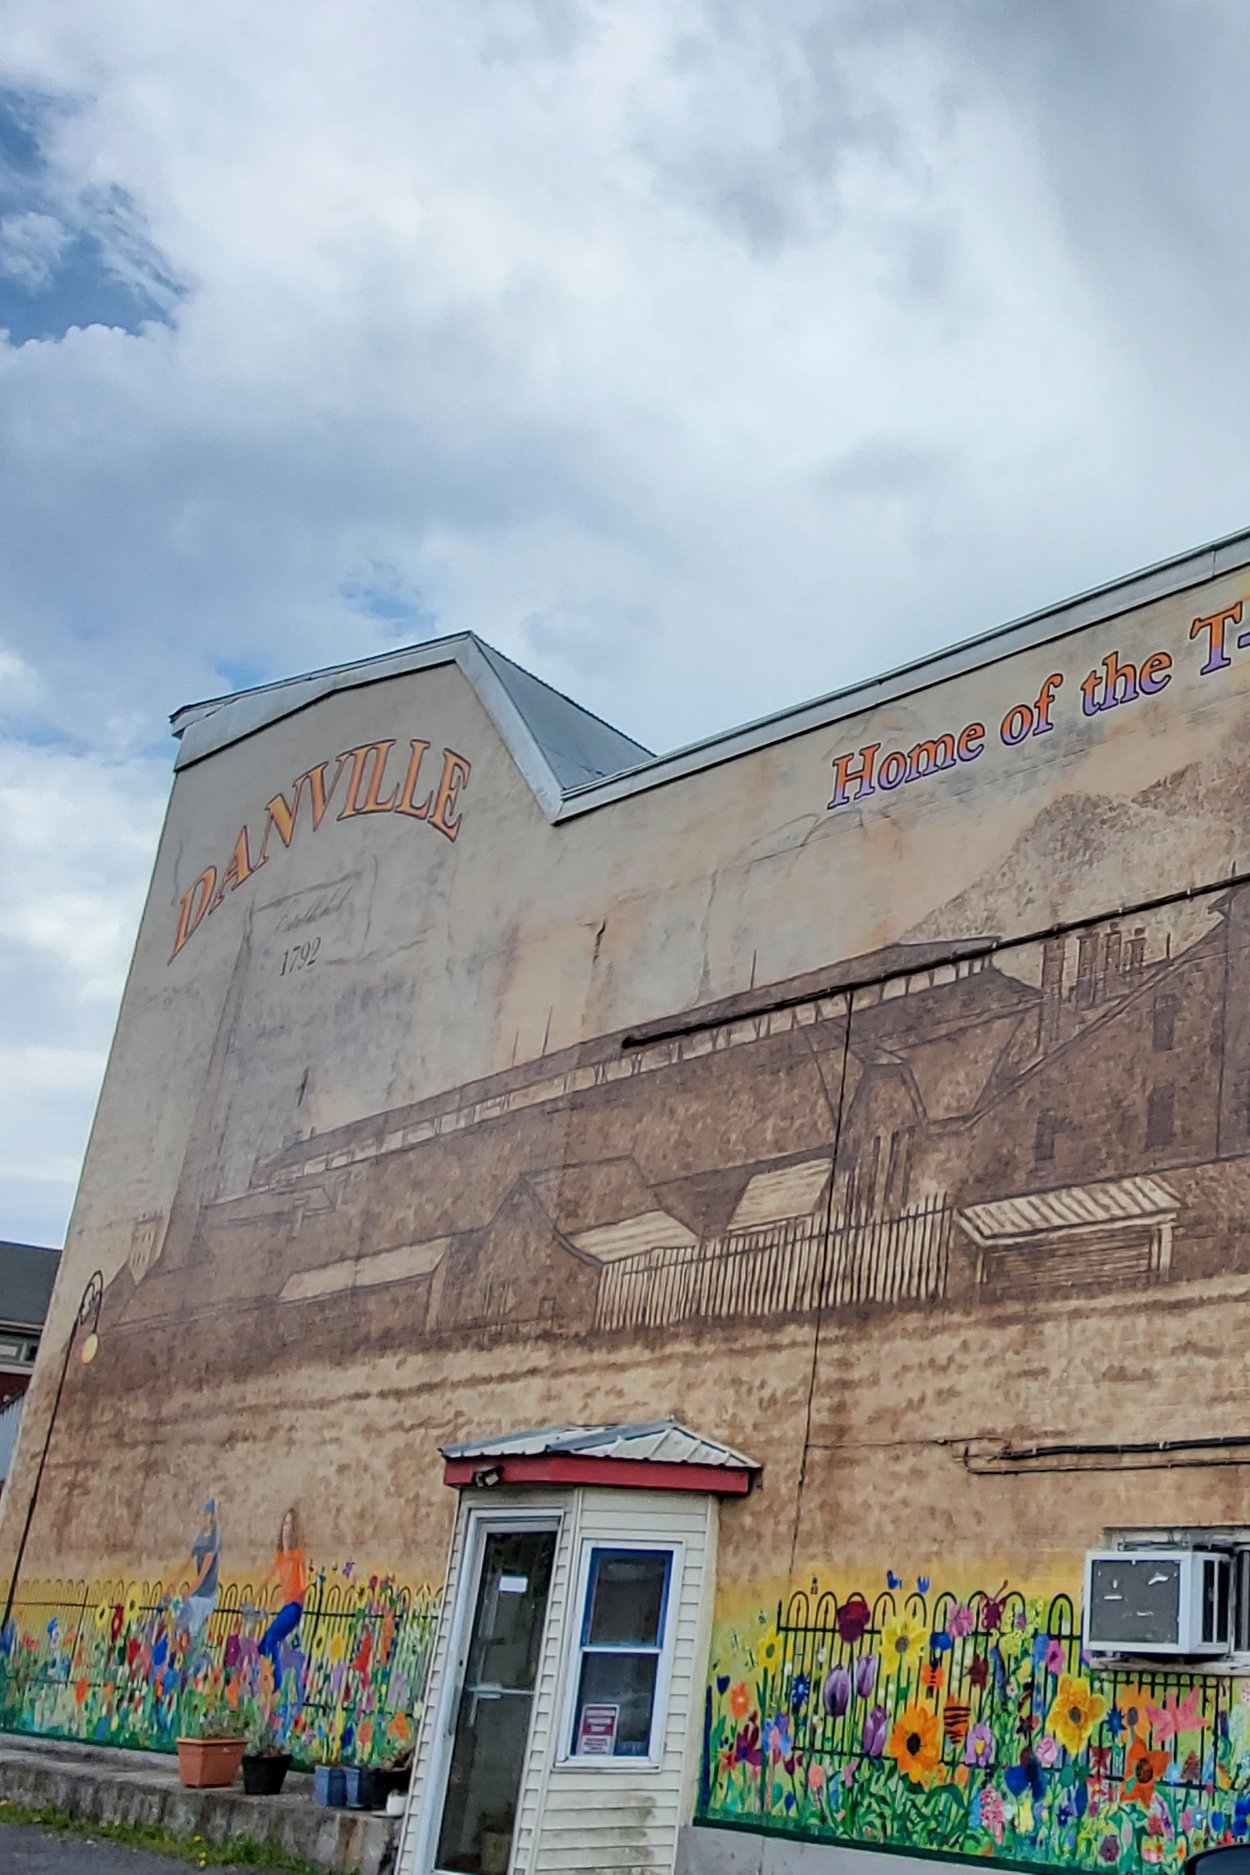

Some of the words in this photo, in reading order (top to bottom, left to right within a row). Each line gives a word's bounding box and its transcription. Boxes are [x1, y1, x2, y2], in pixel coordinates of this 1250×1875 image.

[827, 721, 986, 810] Home
[1000, 673, 1064, 746] of
[1080, 650, 1173, 717] the
[167, 739, 472, 966] DANVILLE
[279, 936, 321, 976] 1792
